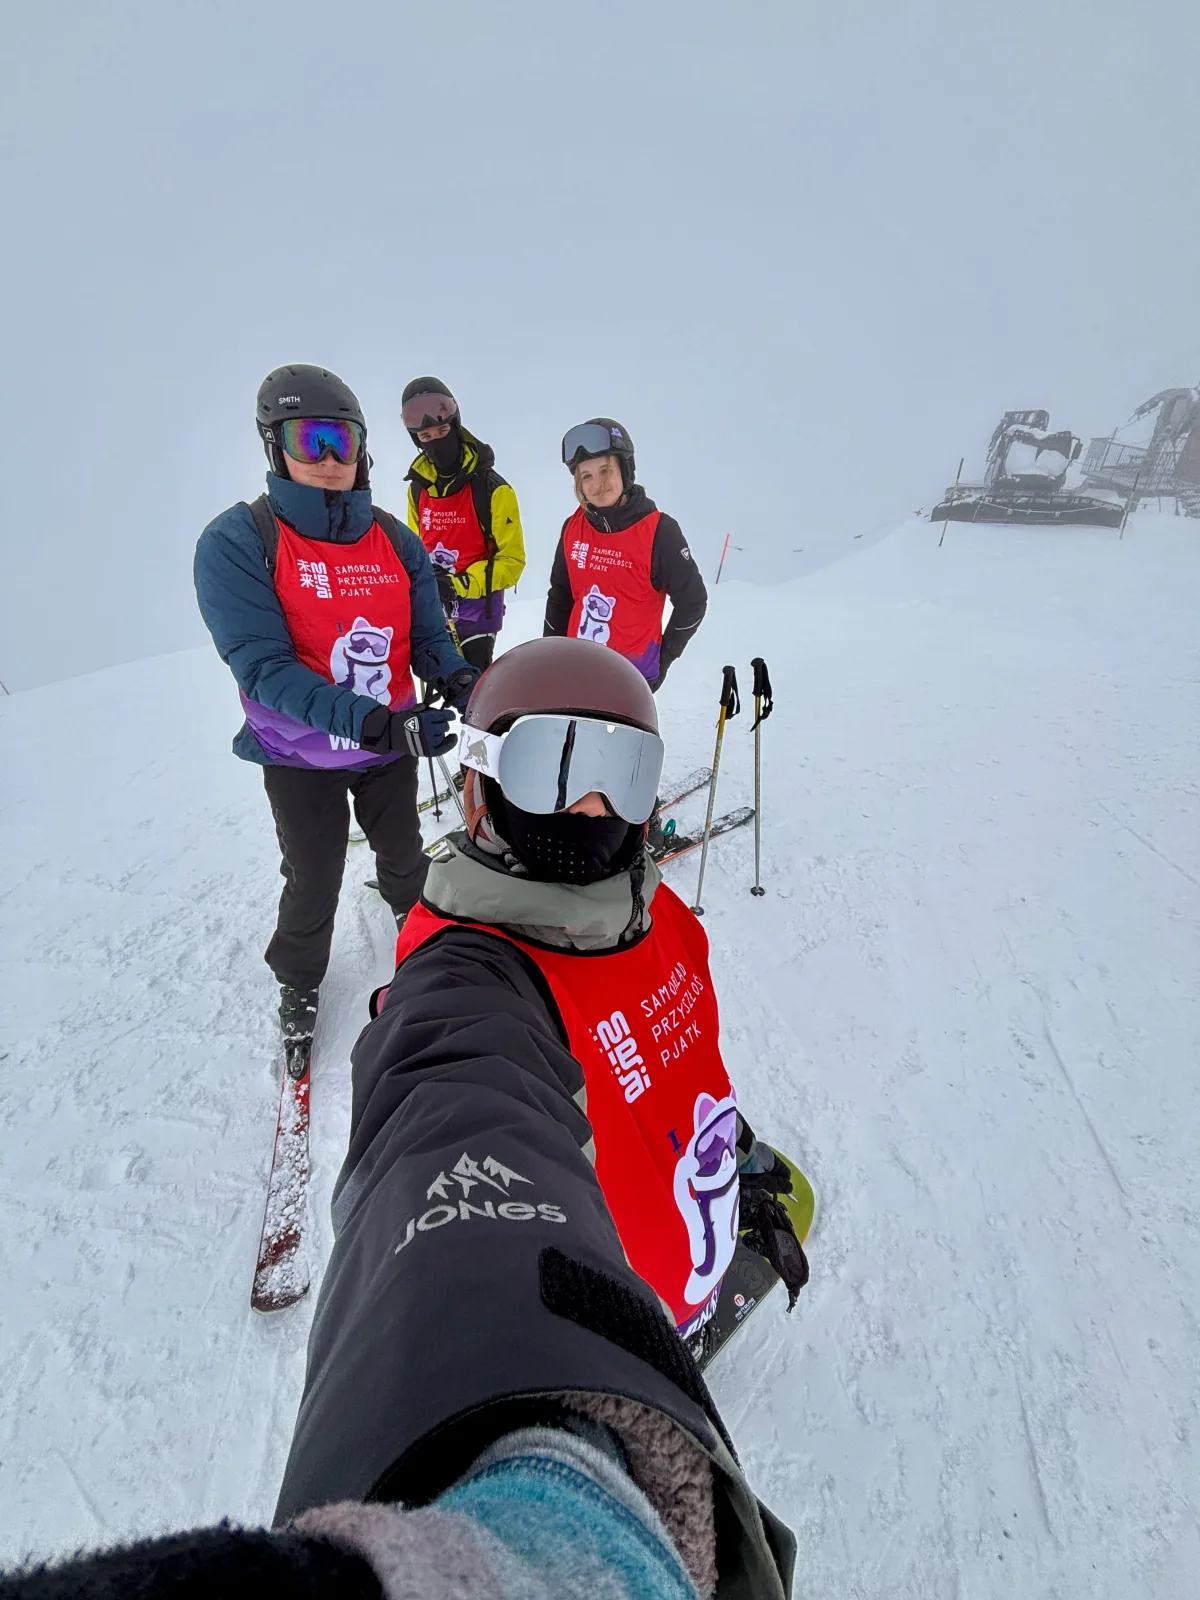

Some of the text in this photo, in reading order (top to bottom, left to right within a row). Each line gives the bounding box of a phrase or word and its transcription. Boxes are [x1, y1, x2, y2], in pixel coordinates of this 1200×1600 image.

[278, 396, 301, 405] SMITH
[334, 564, 381, 575] SAMORZĄD
[589, 562, 609, 573] PJATK
[337, 573, 400, 586] PRZYSZŁOŚCI
[340, 587, 372, 597] PJATK
[651, 973, 704, 1043] PRZYSZŁOŚ
[660, 1019, 702, 1068] PJATK
[394, 1199, 568, 1255] JONES
